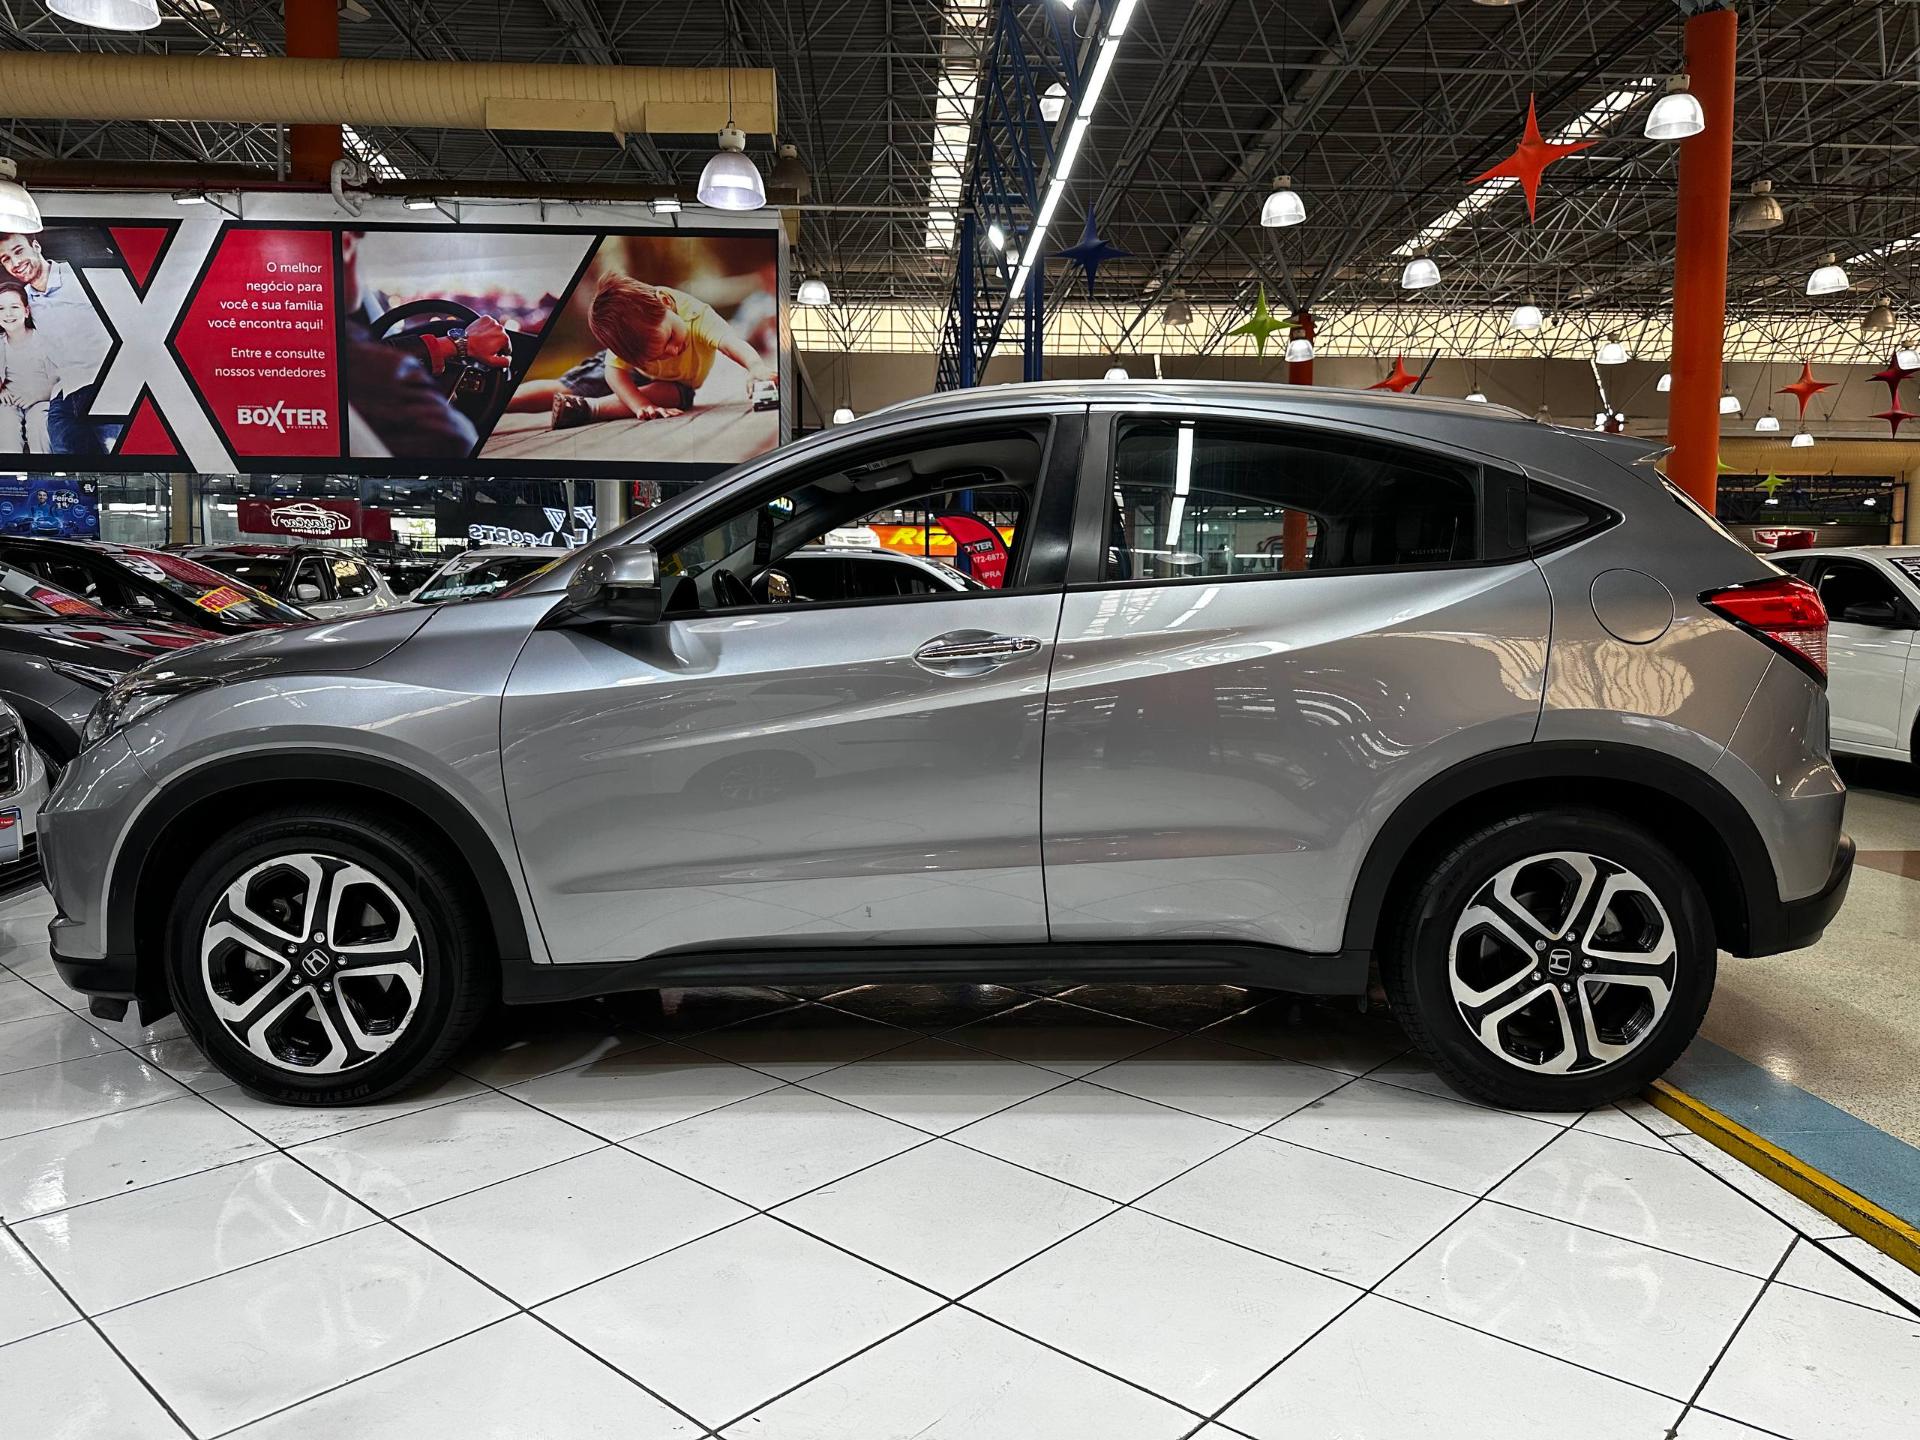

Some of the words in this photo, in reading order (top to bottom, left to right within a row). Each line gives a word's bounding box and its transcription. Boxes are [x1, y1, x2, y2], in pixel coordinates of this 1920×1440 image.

[266, 261, 277, 273] O
[280, 262, 322, 273] melhor
[246, 281, 294, 294] negócio
[297, 284, 323, 294] para
[220, 299, 249, 310] você
[251, 301, 259, 310] e
[261, 301, 282, 311] sua
[285, 299, 323, 311] família
[208, 317, 237, 329] você
[239, 318, 292, 330] encontra
[295, 318, 324, 332] aqui!
[231, 347, 262, 358] Entre
[264, 350, 272, 358] e
[275, 348, 326, 359] consulte
[215, 367, 255, 377] nossos
[258, 367, 326, 378] vendedores
[237, 400, 328, 434] BOXTER
